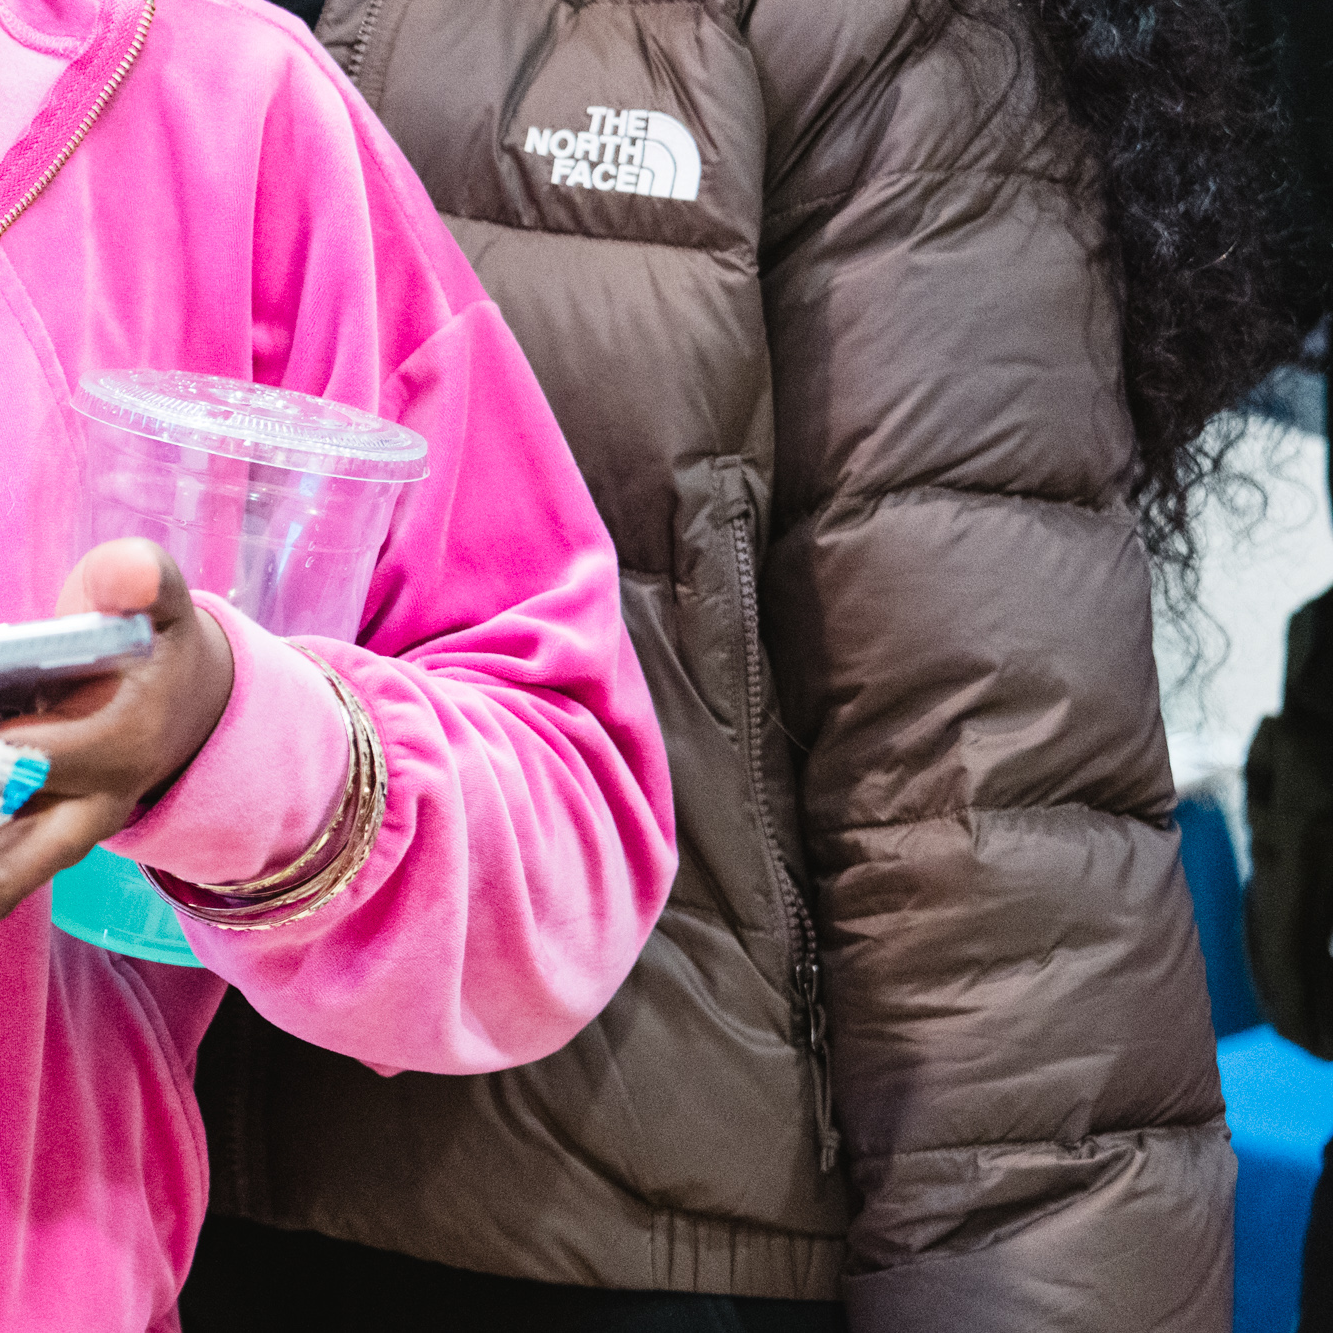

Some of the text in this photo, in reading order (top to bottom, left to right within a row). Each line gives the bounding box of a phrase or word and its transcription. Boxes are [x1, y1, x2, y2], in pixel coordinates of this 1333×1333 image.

[586, 105, 649, 139] THE
[523, 126, 645, 166] NORTH
[550, 157, 640, 194] FACE
